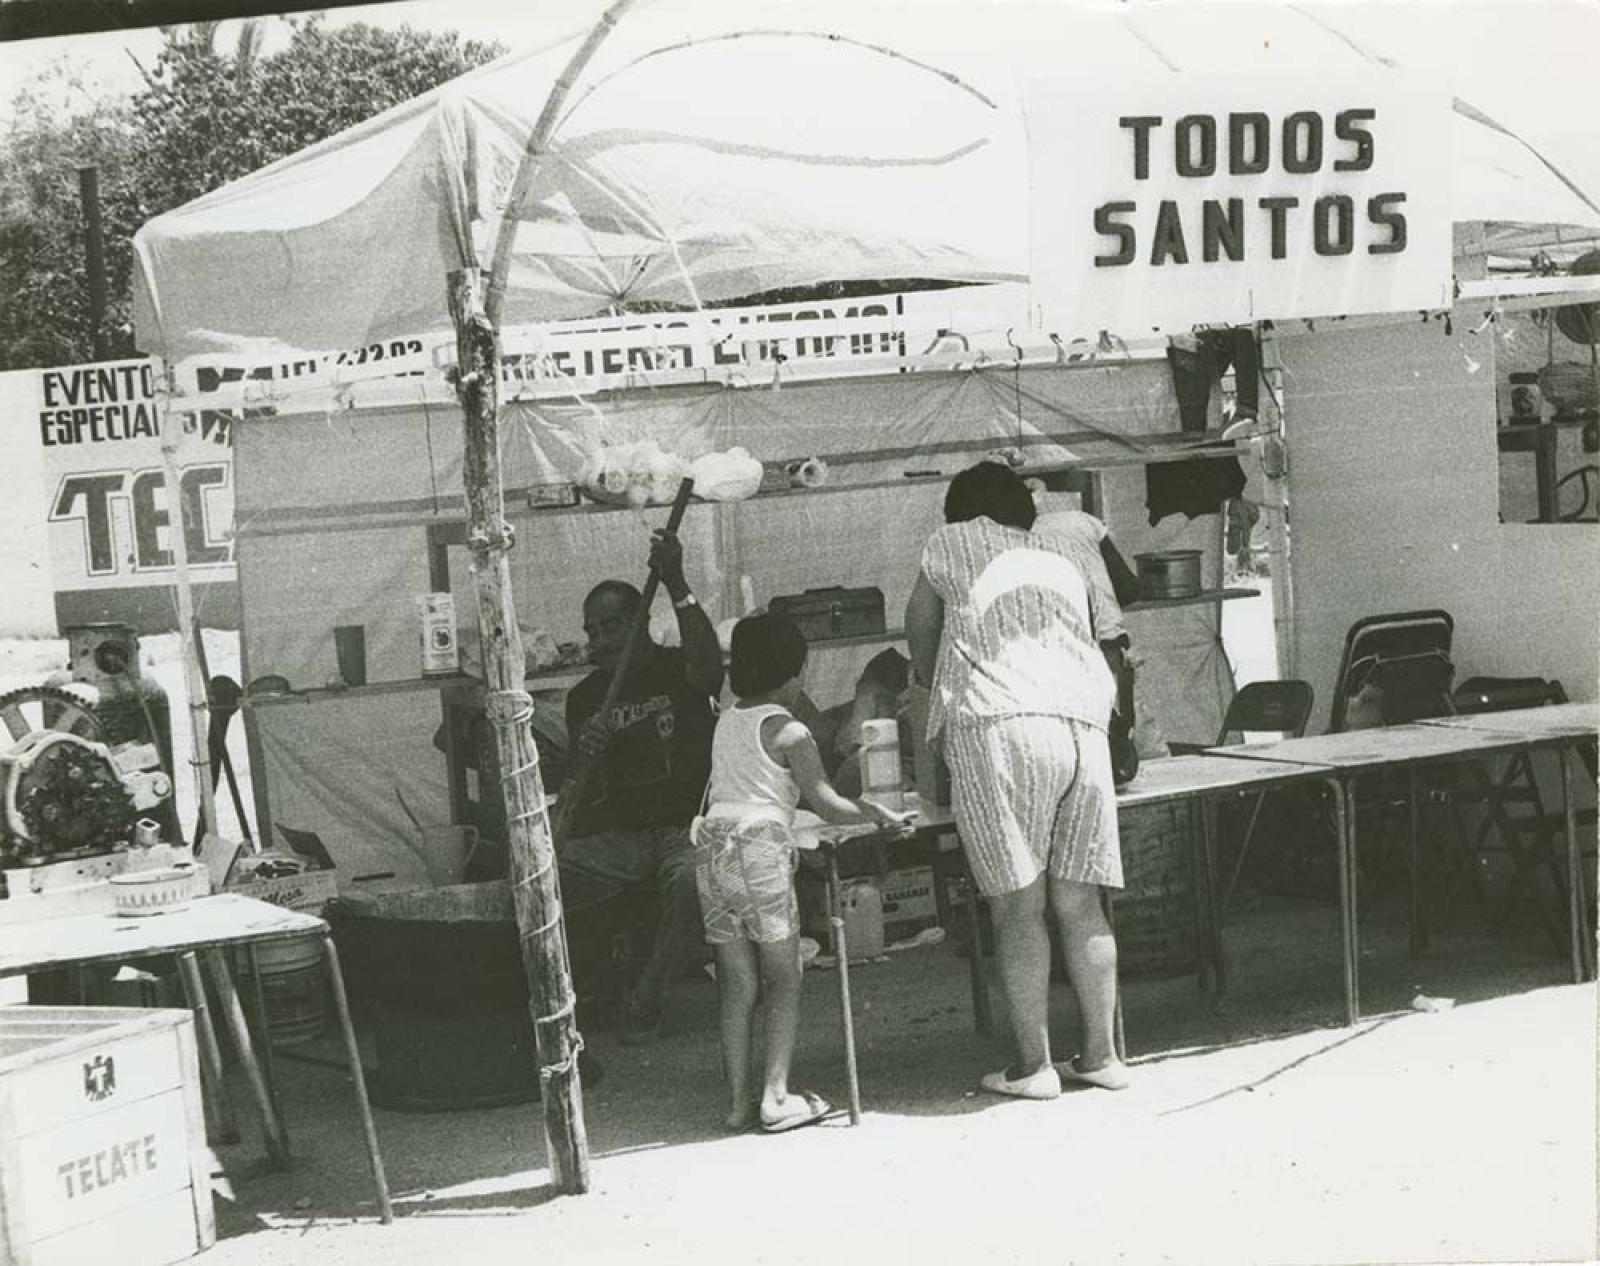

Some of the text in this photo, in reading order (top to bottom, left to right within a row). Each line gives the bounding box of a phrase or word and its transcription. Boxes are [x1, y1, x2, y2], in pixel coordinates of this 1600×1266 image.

[1119, 108, 1376, 179] TODOS
[1094, 192, 1407, 267] SANTOS
[42, 364, 155, 408] EVENTO
[48, 461, 237, 577] TEC
[57, 1133, 158, 1200] TECATE
